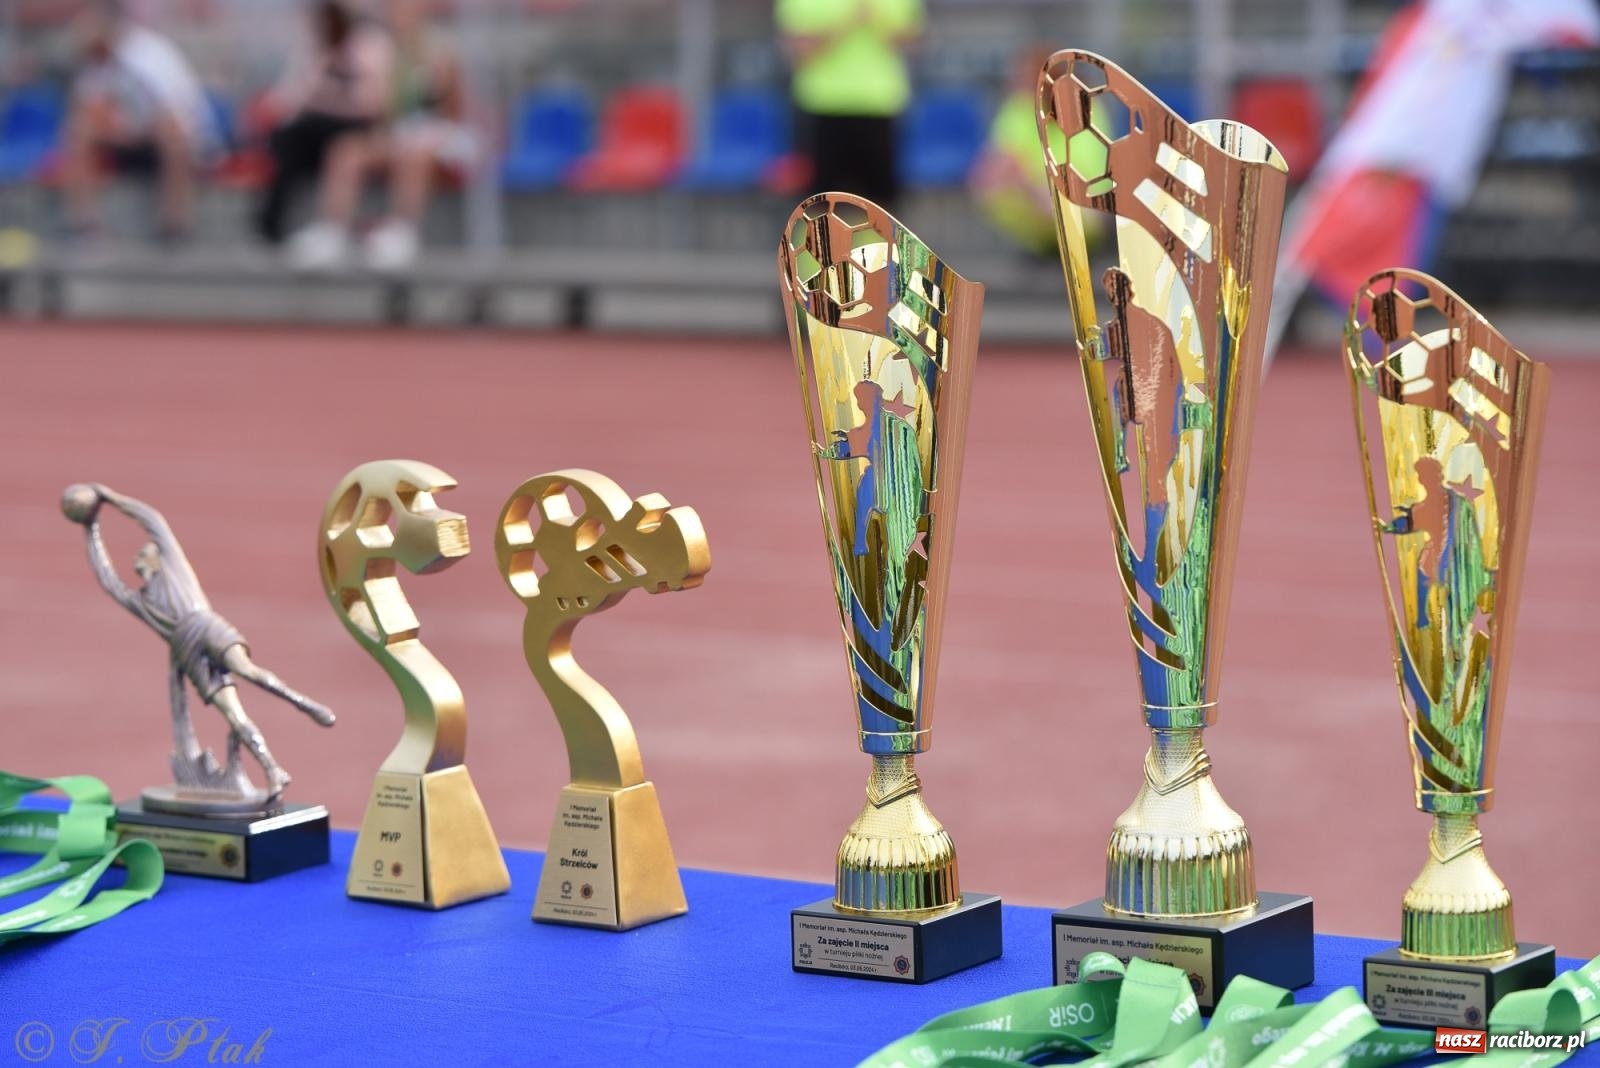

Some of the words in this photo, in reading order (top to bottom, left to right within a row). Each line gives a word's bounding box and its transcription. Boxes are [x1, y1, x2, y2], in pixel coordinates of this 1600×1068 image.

[380, 831, 402, 842] MVP
[572, 848, 588, 858] Król
[560, 858, 598, 870] Strzelców
[848, 928, 870, 936] Michała
[870, 930, 908, 940] Kędzierskiego
[818, 936, 827, 944] Za
[828, 938, 854, 948] zajęcie
[860, 942, 889, 952] miejsca
[1066, 934, 1098, 944] Memoriał
[1100, 937, 1109, 946] im.
[1112, 939, 1124, 948] asp.
[1127, 940, 1154, 950] Michała
[1155, 942, 1204, 956] Kędzierskiego
[1386, 984, 1396, 994] Za
[1397, 986, 1424, 997] zajęcie
[1435, 990, 1466, 1000] miejsca
[1050, 1002, 1094, 1028] OSiR
